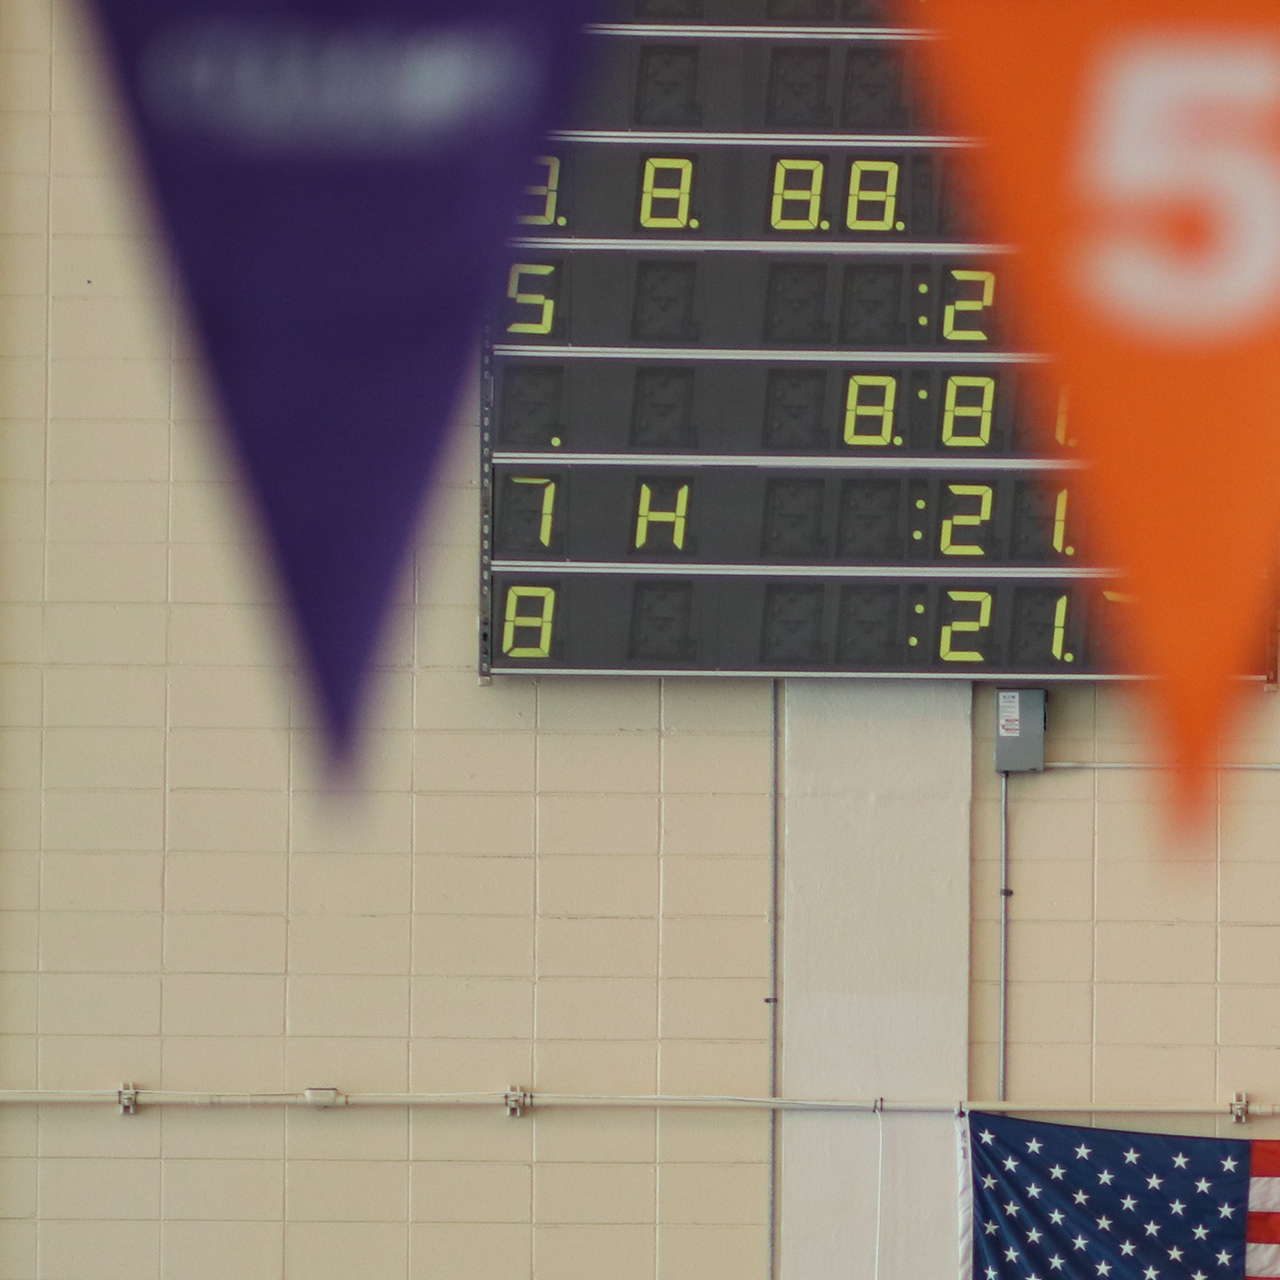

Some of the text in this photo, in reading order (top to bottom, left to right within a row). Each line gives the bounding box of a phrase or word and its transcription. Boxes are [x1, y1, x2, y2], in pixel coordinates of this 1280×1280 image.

[507, 263, 555, 335] 5
[511, 477, 556, 548] 7
[635, 482, 689, 551] H
[502, 585, 555, 659] 8
